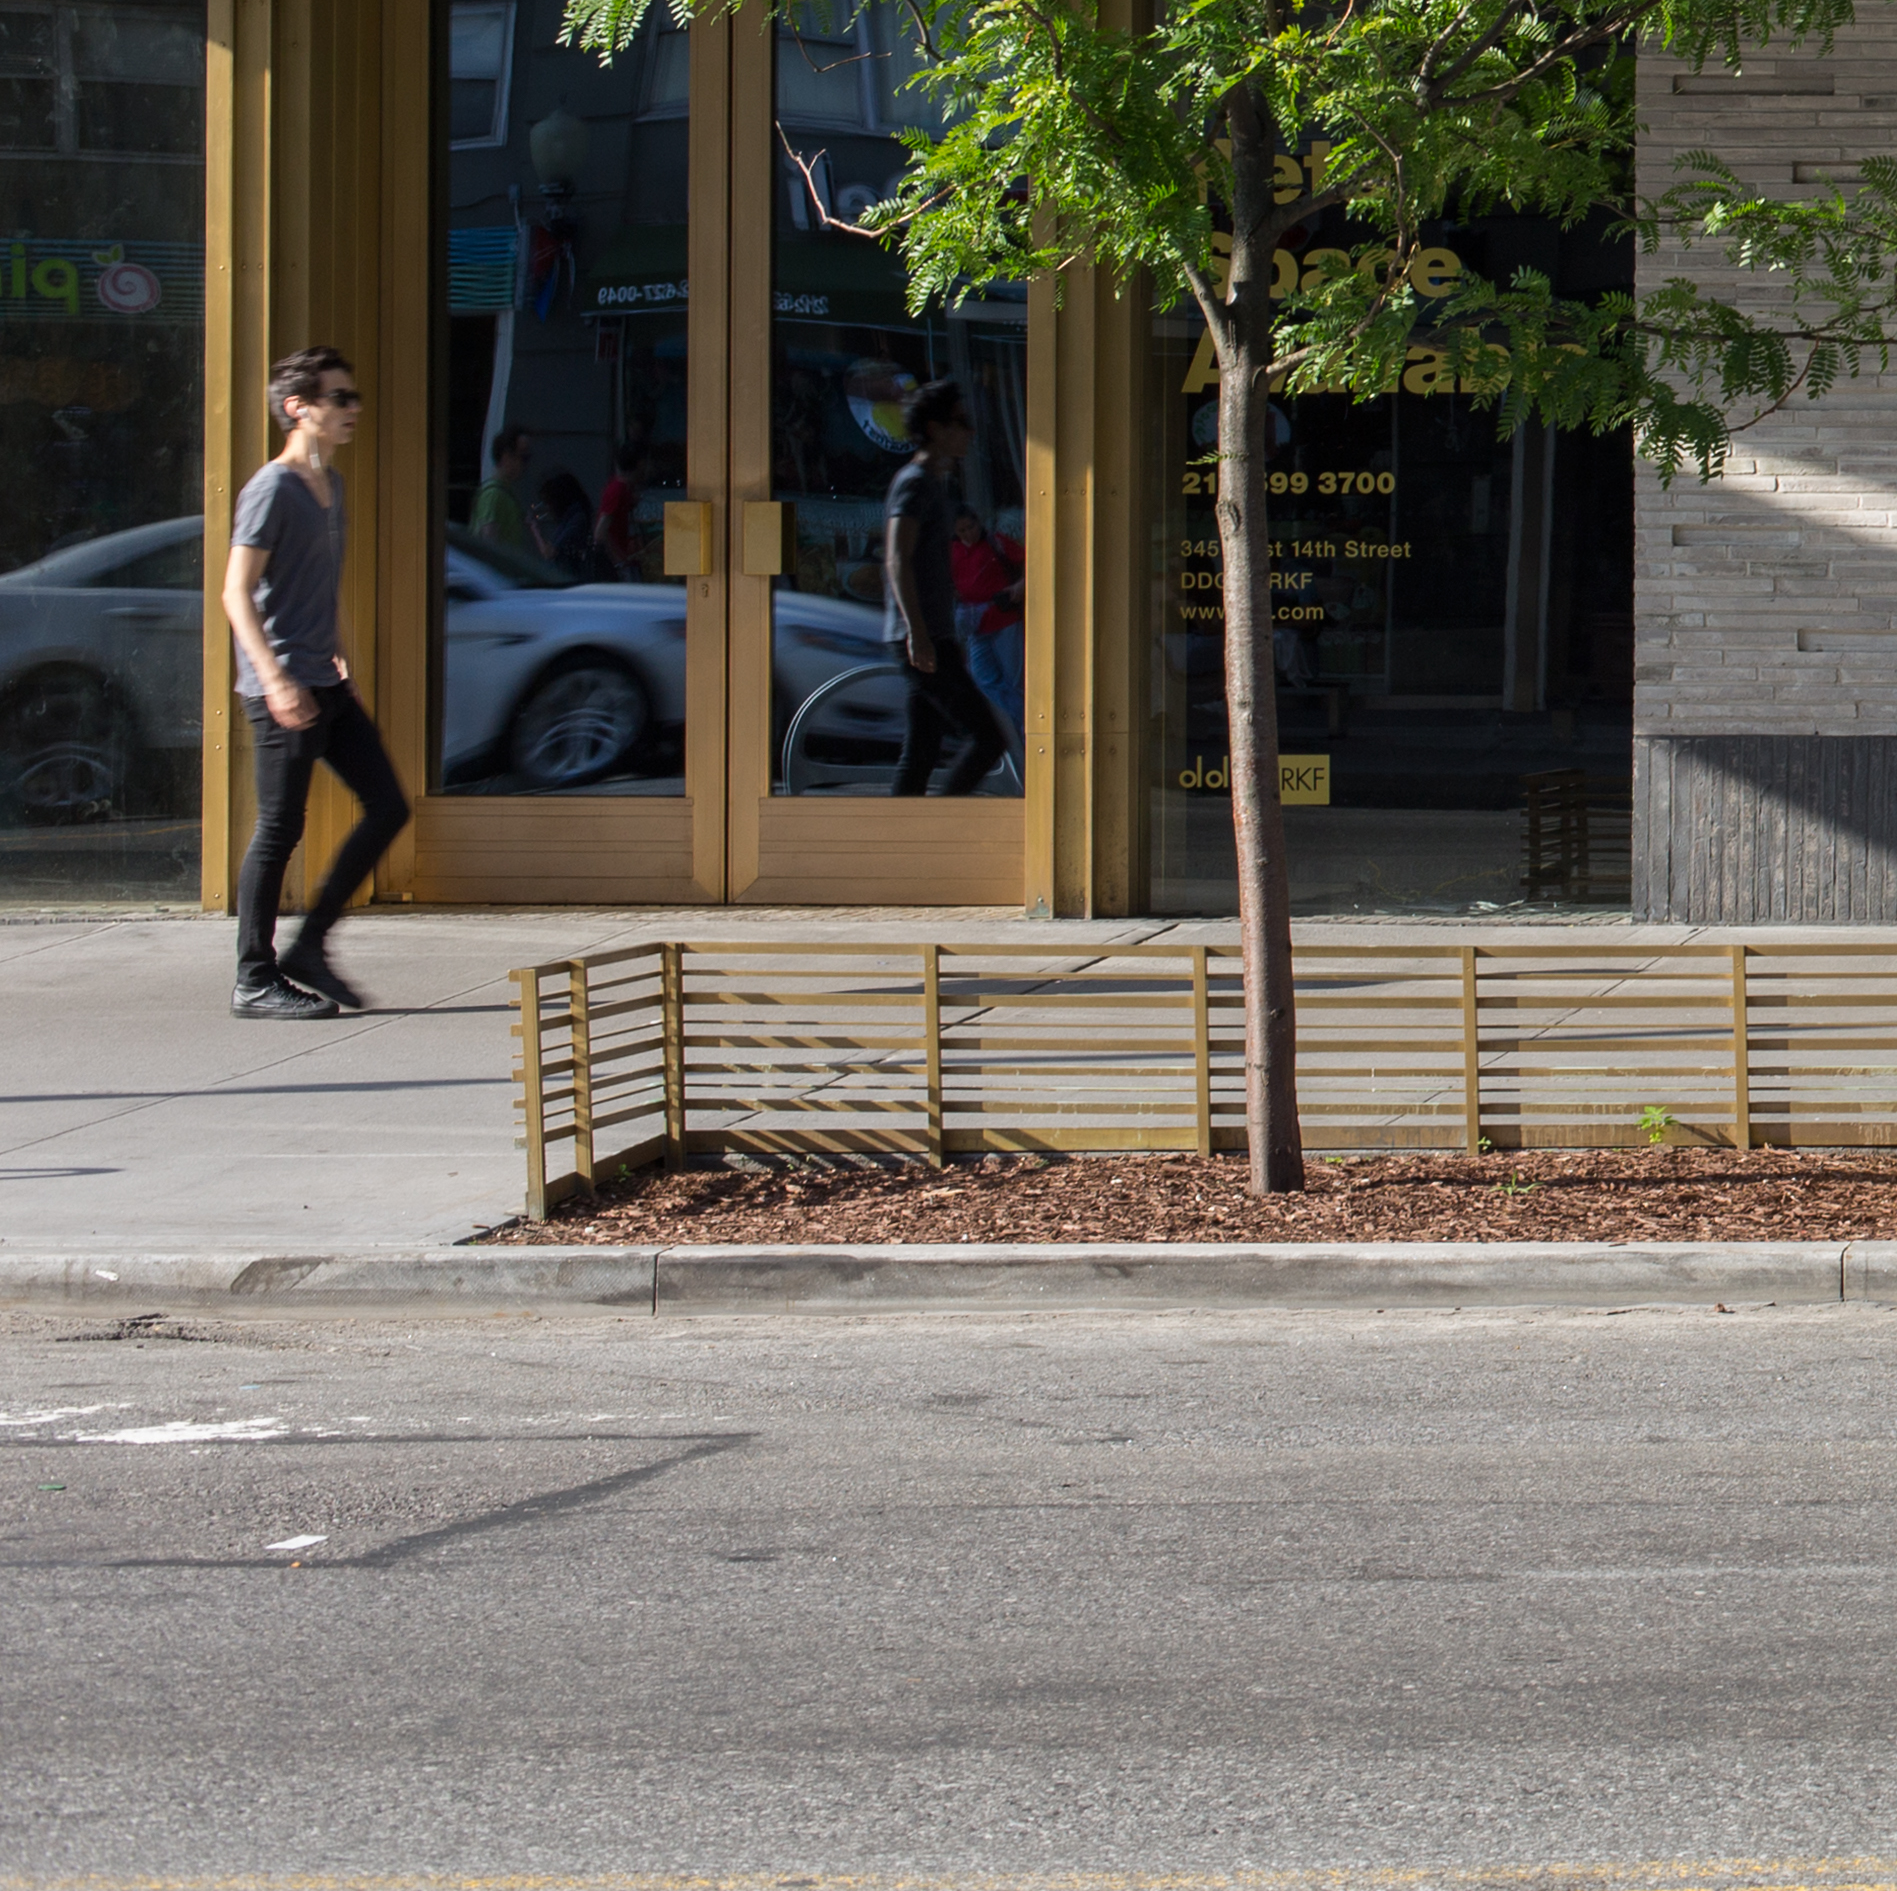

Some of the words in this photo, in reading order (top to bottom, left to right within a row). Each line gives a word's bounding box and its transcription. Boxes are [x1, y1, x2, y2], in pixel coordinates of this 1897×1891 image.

[1181, 471, 1216, 495] 21
[1264, 471, 1310, 495] 99
[1317, 471, 1396, 495] 3700
[1180, 540, 1220, 558] 345
[1291, 540, 1336, 558] 14th
[1344, 540, 1412, 558] Street
[1281, 767, 1325, 791] RKF
